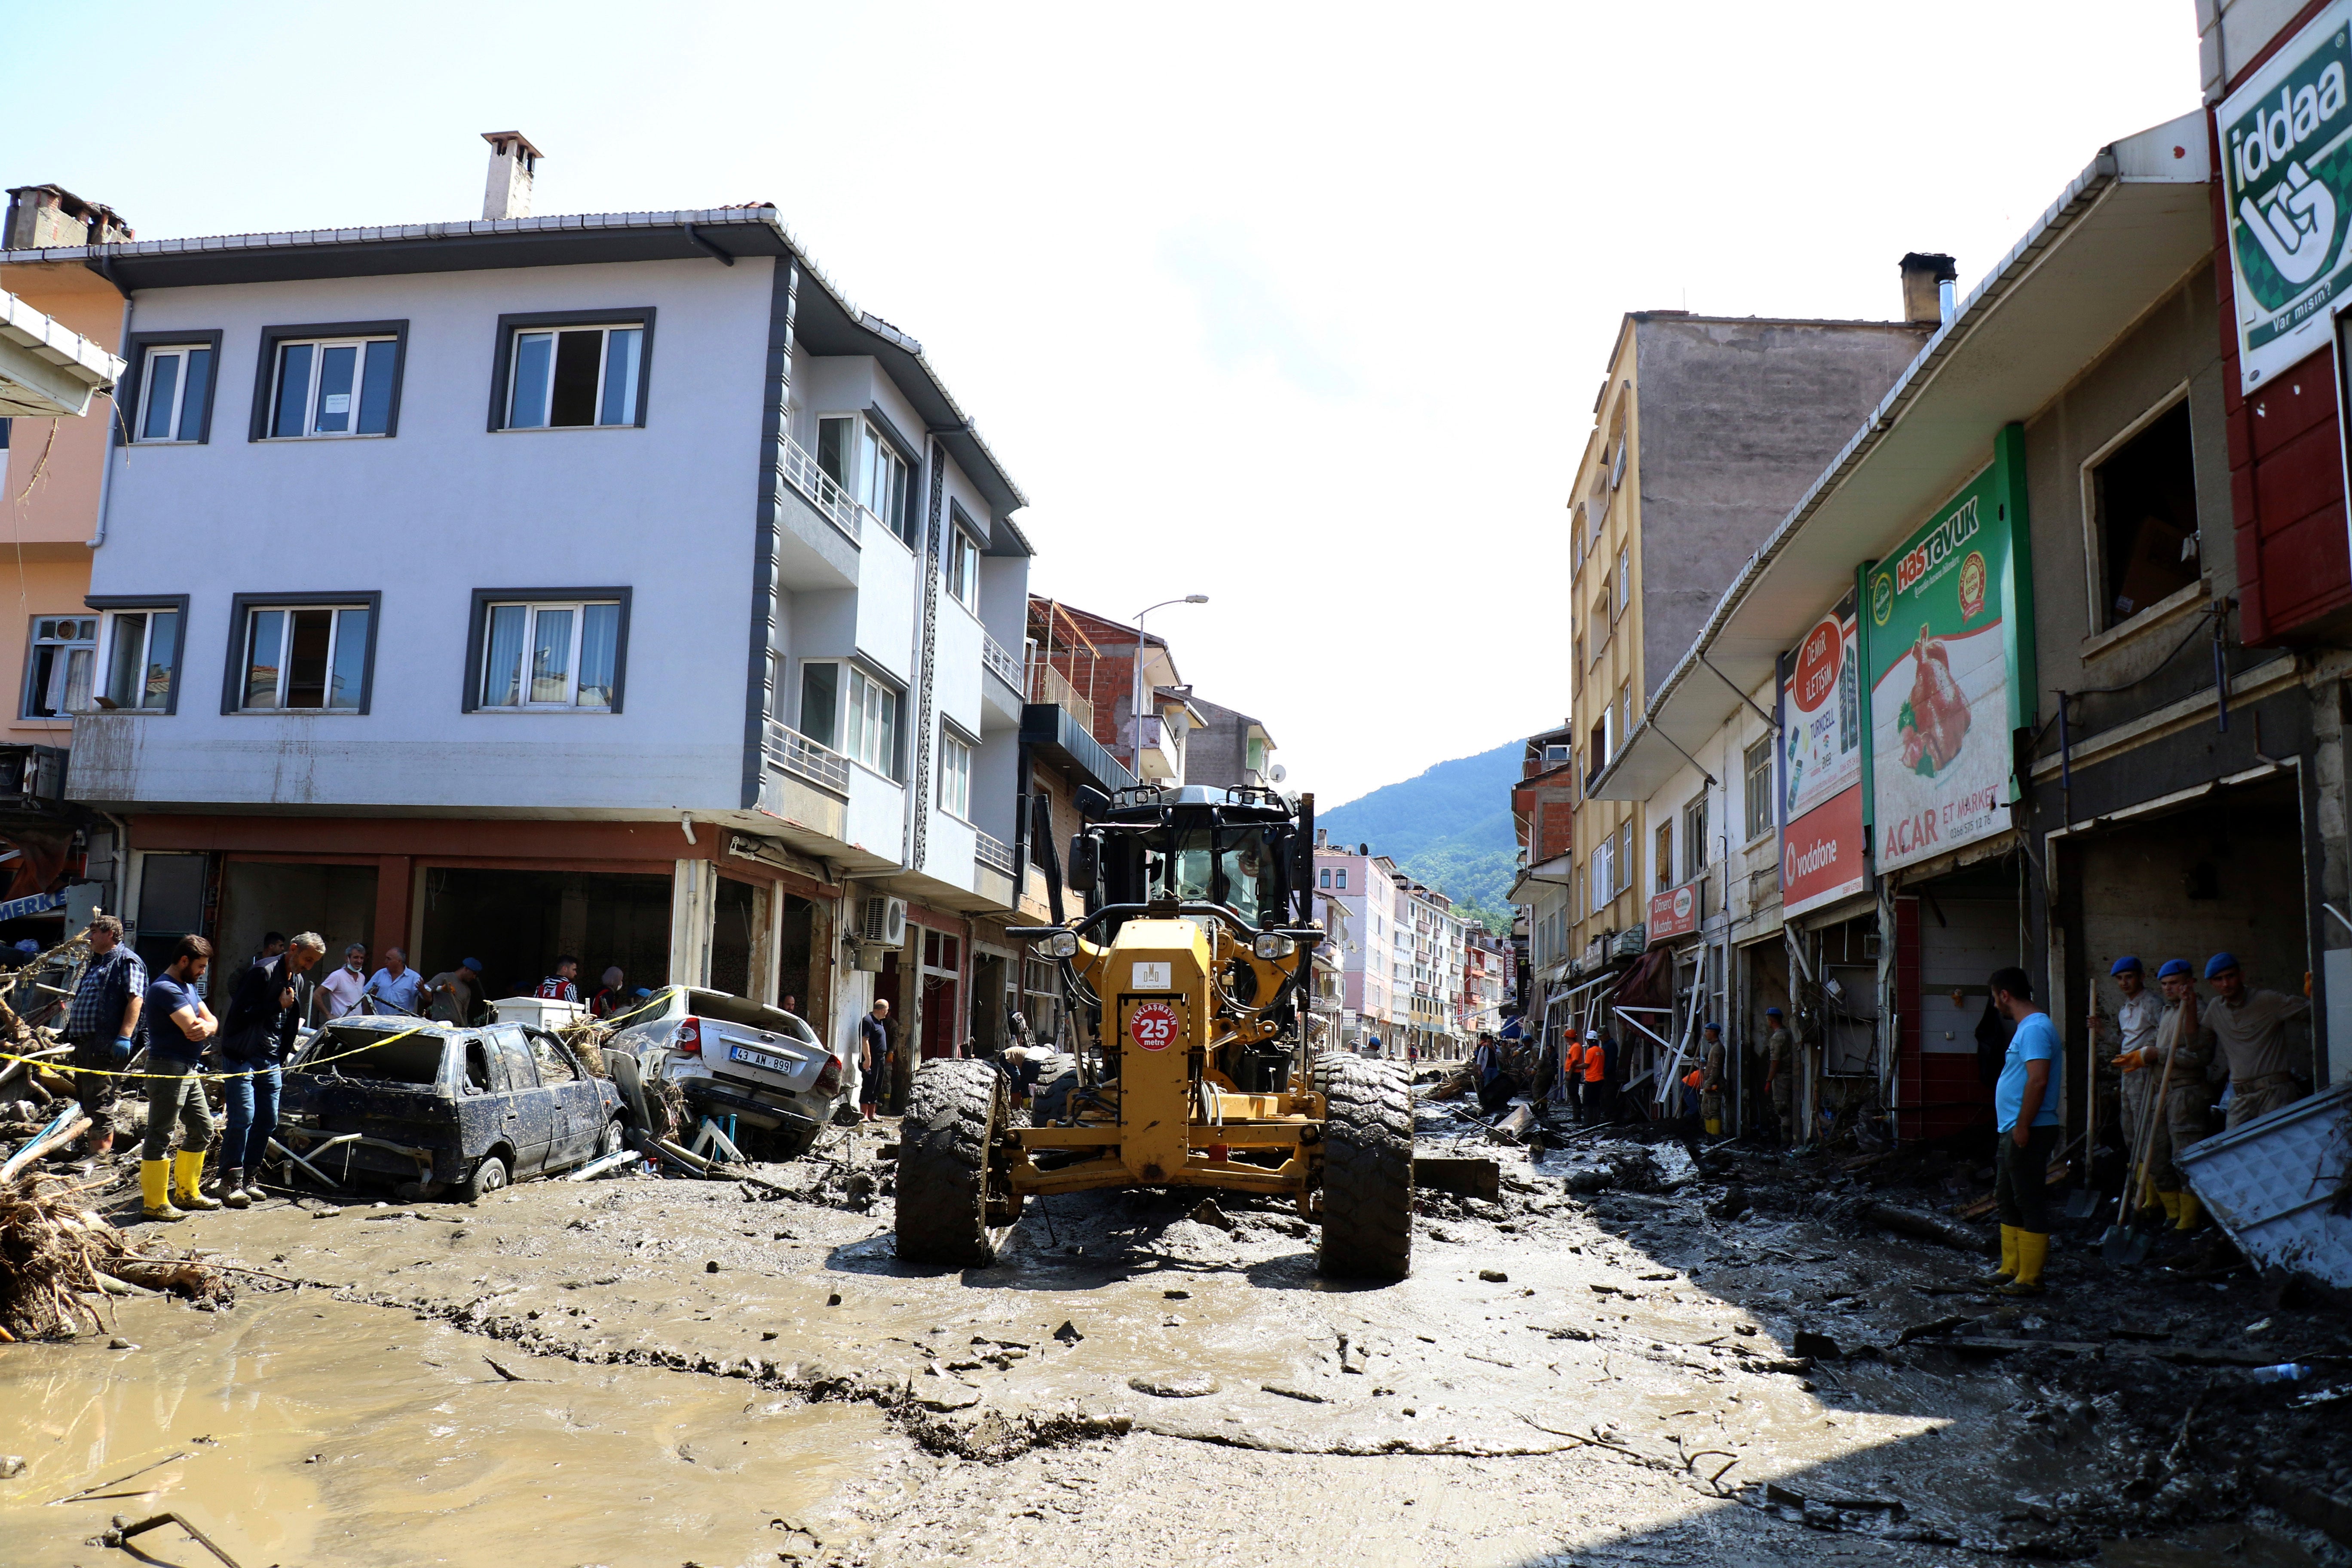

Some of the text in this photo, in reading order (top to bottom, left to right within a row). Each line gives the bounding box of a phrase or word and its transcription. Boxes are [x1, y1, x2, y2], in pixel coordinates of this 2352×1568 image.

[2232, 61, 2347, 193] iddaa
[2273, 313, 2291, 332] Var
[1807, 631, 1826, 667] DEMİR
[1806, 661, 1832, 702] İLETİŞİM
[1810, 707, 1835, 741] TURKCELL
[1943, 784, 1998, 824] ET MARKET
[1885, 809, 1939, 860] ACAR
[1950, 815, 1991, 839] 0366 575 12 76
[1797, 839, 1837, 877] vodafone
[0, 888, 69, 921] MERKE
[1655, 895, 1672, 913] Dönerci
[1654, 916, 1672, 934] Mustafa
[1132, 1004, 1177, 1026] YAKLAŞMAYIN
[1140, 1019, 1169, 1038] 25
[738, 1049, 789, 1071] 43 AN 899
